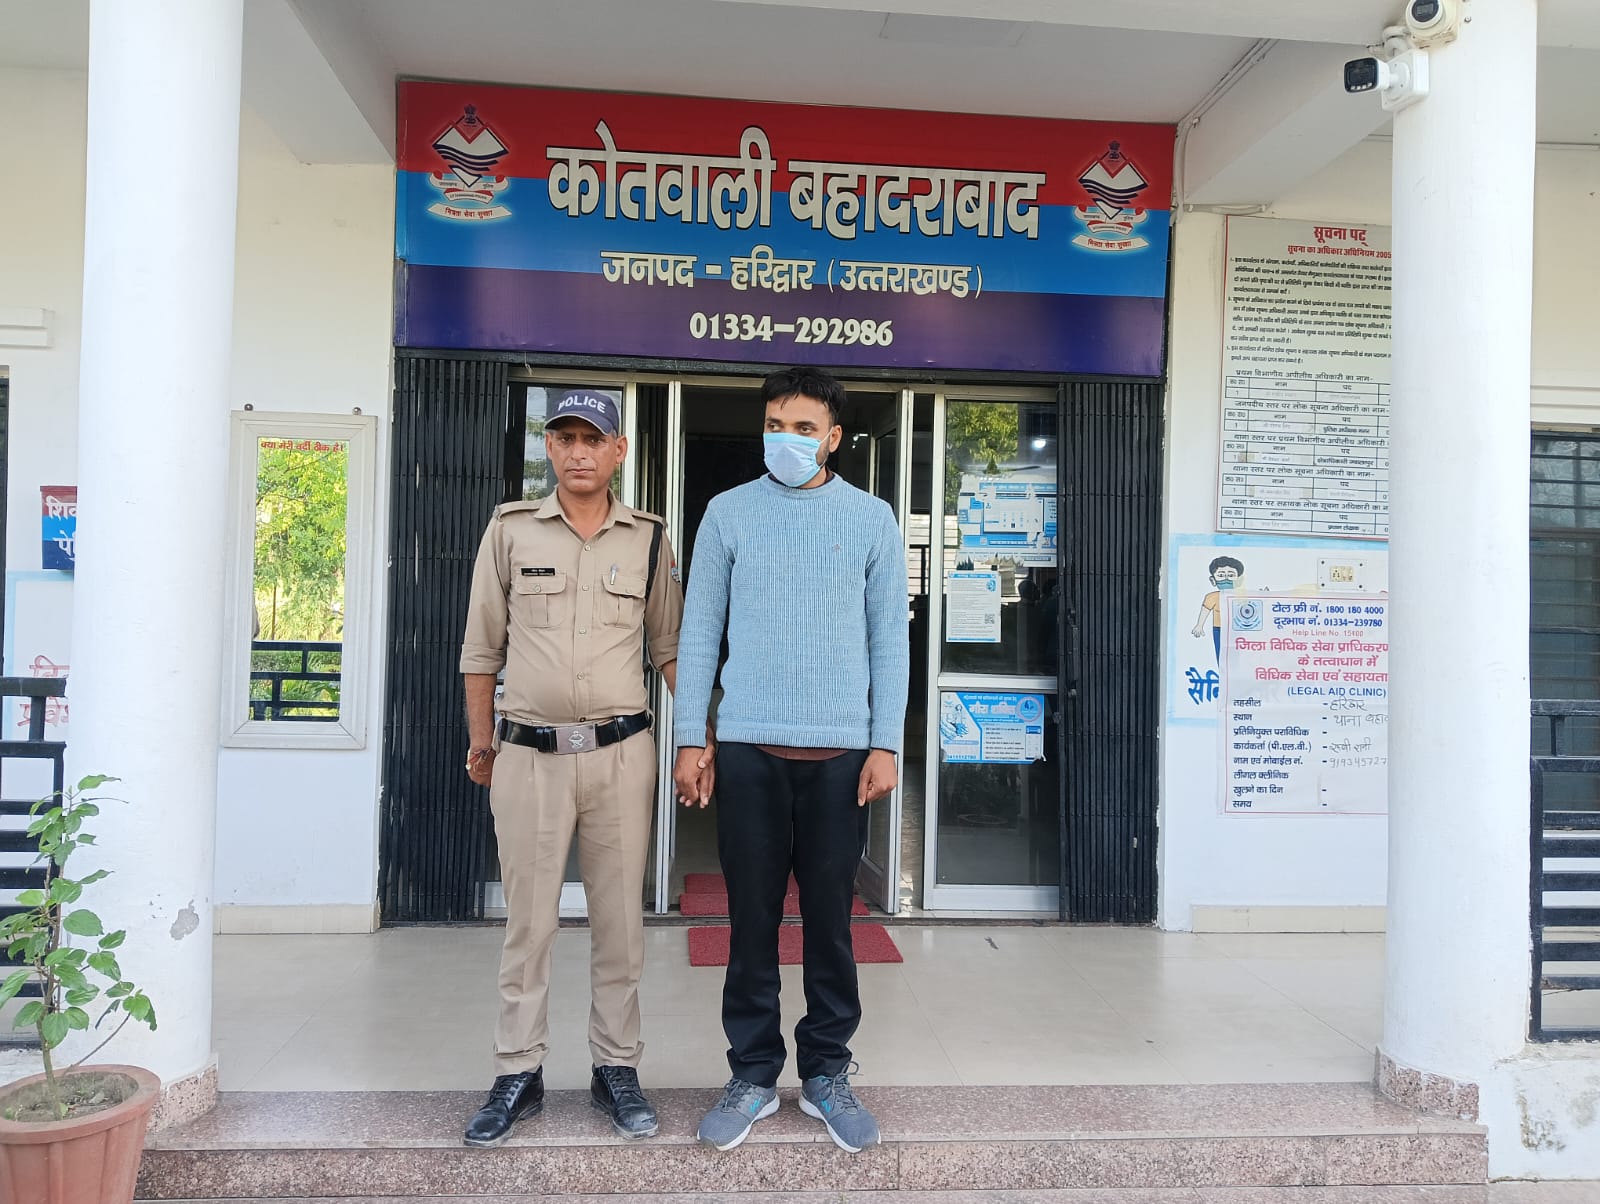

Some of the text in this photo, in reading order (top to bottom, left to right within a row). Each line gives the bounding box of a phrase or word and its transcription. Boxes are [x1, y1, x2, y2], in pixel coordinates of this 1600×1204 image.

[546, 119, 1046, 240] कोतवाली बहादराबाद
[1313, 226, 1346, 243] सूचना
[1288, 245, 1306, 255] सूचना
[1306, 246, 1316, 254] का
[1317, 246, 1343, 256] अधिकार
[1343, 247, 1374, 257] अधिनियम
[600, 251, 697, 288] जनपद
[730, 245, 816, 293] हरिद्वार
[689, 312, 893, 347] 01334-292986
[1235, 369, 1253, 377] प्रथम
[1286, 370, 1313, 379] अपीलीय
[1315, 371, 1343, 380] अधिकारी
[557, 395, 606, 414] POLICE
[1234, 400, 1263, 408] जनपदीय
[1265, 401, 1280, 409] स्तर
[1292, 402, 1307, 410] लोक
[1310, 404, 1329, 412] सूचना
[1331, 404, 1359, 412] अधिकारी
[260, 440, 276, 449] क्या
[278, 440, 293, 450] मेरी
[296, 440, 310, 451] वर्दी
[314, 441, 329, 452] ठीक
[1278, 435, 1295, 443] प्रथम
[1327, 436, 1355, 445] अपीलीय
[1357, 437, 1385, 446] अधिकारी
[1277, 466, 1293, 474] लोक
[1294, 468, 1313, 477] सूचना
[1316, 468, 1344, 477] अधिकारी
[1303, 500, 1318, 508] लोक
[1320, 502, 1339, 511] सूचना
[1341, 502, 1370, 511] अधिकारी
[1271, 602, 1291, 614] टोल
[1293, 602, 1307, 614] फ्री
[1326, 605, 1344, 614] 1800
[1348, 605, 1362, 614] 180
[1364, 606, 1384, 614] 4000
[1273, 616, 1305, 629] दूरभाष
[1323, 618, 1383, 627] 01334-239780
[1292, 629, 1309, 637] Help
[1235, 637, 1266, 651] जिला
[1270, 637, 1308, 651] विधिक
[1311, 640, 1334, 652] सेवा
[1297, 654, 1379, 667] के तत्वाधान में
[1255, 667, 1388, 683] विधिक सेवा एवं सहायता
[1287, 686, 1387, 698] (LEGAL AID CLINIC)
[1233, 697, 1262, 708] तहसील
[1233, 712, 1253, 721] स्थान
[1233, 726, 1310, 739] प्रतिनियुक्त पराविधिक
[1233, 740, 1266, 751] कार्यकर्ता
[1233, 757, 1249, 765] नाम
[1250, 755, 1261, 765] एवं
[1233, 769, 1289, 780] लीगल क्लीनिक
[1233, 784, 1284, 797] खुलने का दिन
[1232, 800, 1253, 808] समय
